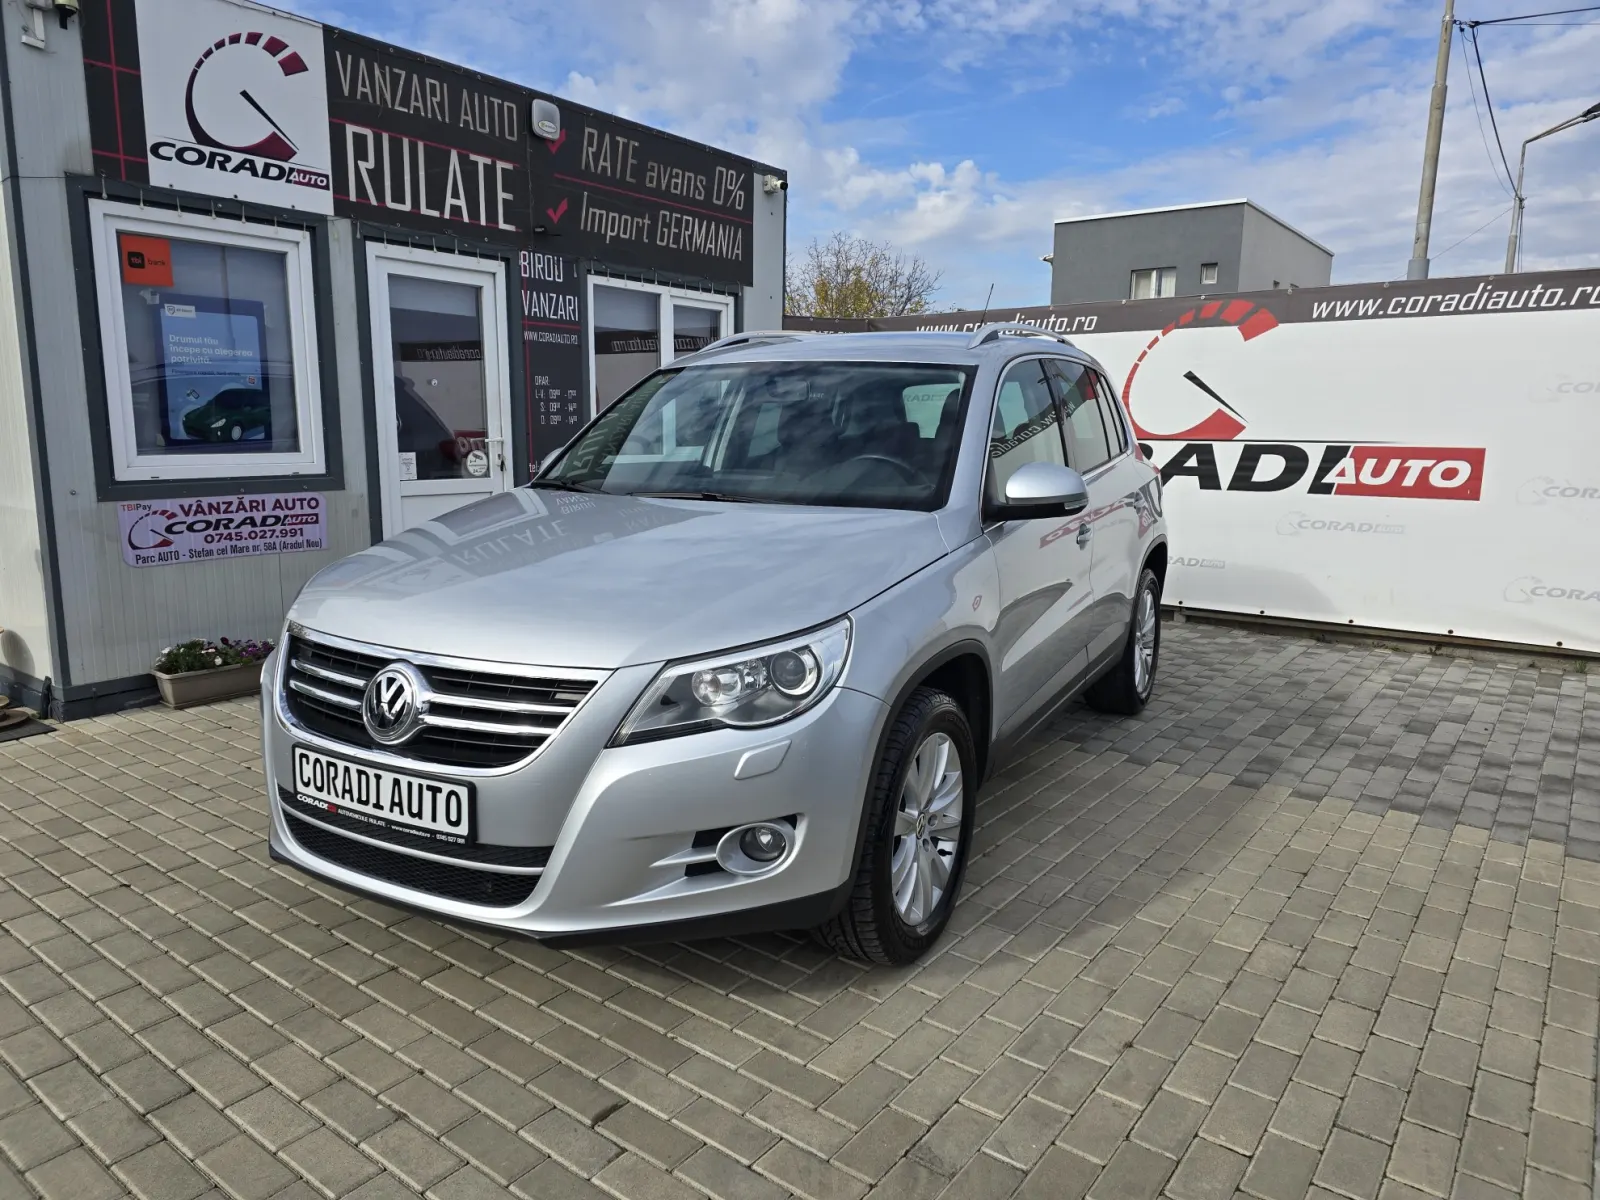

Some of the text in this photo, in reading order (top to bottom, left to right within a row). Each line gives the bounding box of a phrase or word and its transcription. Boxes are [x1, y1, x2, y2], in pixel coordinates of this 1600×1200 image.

[335, 50, 518, 142] VANZARI AUTO
[289, 172, 328, 187] AUTO
[346, 124, 516, 231] RULATE
[581, 127, 746, 211] RATE avans 0%
[580, 191, 743, 262] Import GERMANIA
[520, 251, 564, 283] BIROU
[521, 290, 579, 321] VANZARI
[169, 334, 202, 344] Drumul
[1322, 458, 1472, 488] AUTO
[121, 502, 152, 513] TBIPay
[178, 496, 320, 518] VÂNZĂRI AUTO
[286, 514, 318, 524] AUTO
[204, 527, 304, 544] 0745.027.991
[136, 553, 156, 565] Parc
[158, 552, 180, 563] AUTO
[216, 546, 229, 556] cel
[230, 544, 251, 555] Mare
[252, 544, 263, 553] nr.
[263, 541, 278, 552] 58A
[299, 752, 463, 828] CORADI AUTO
